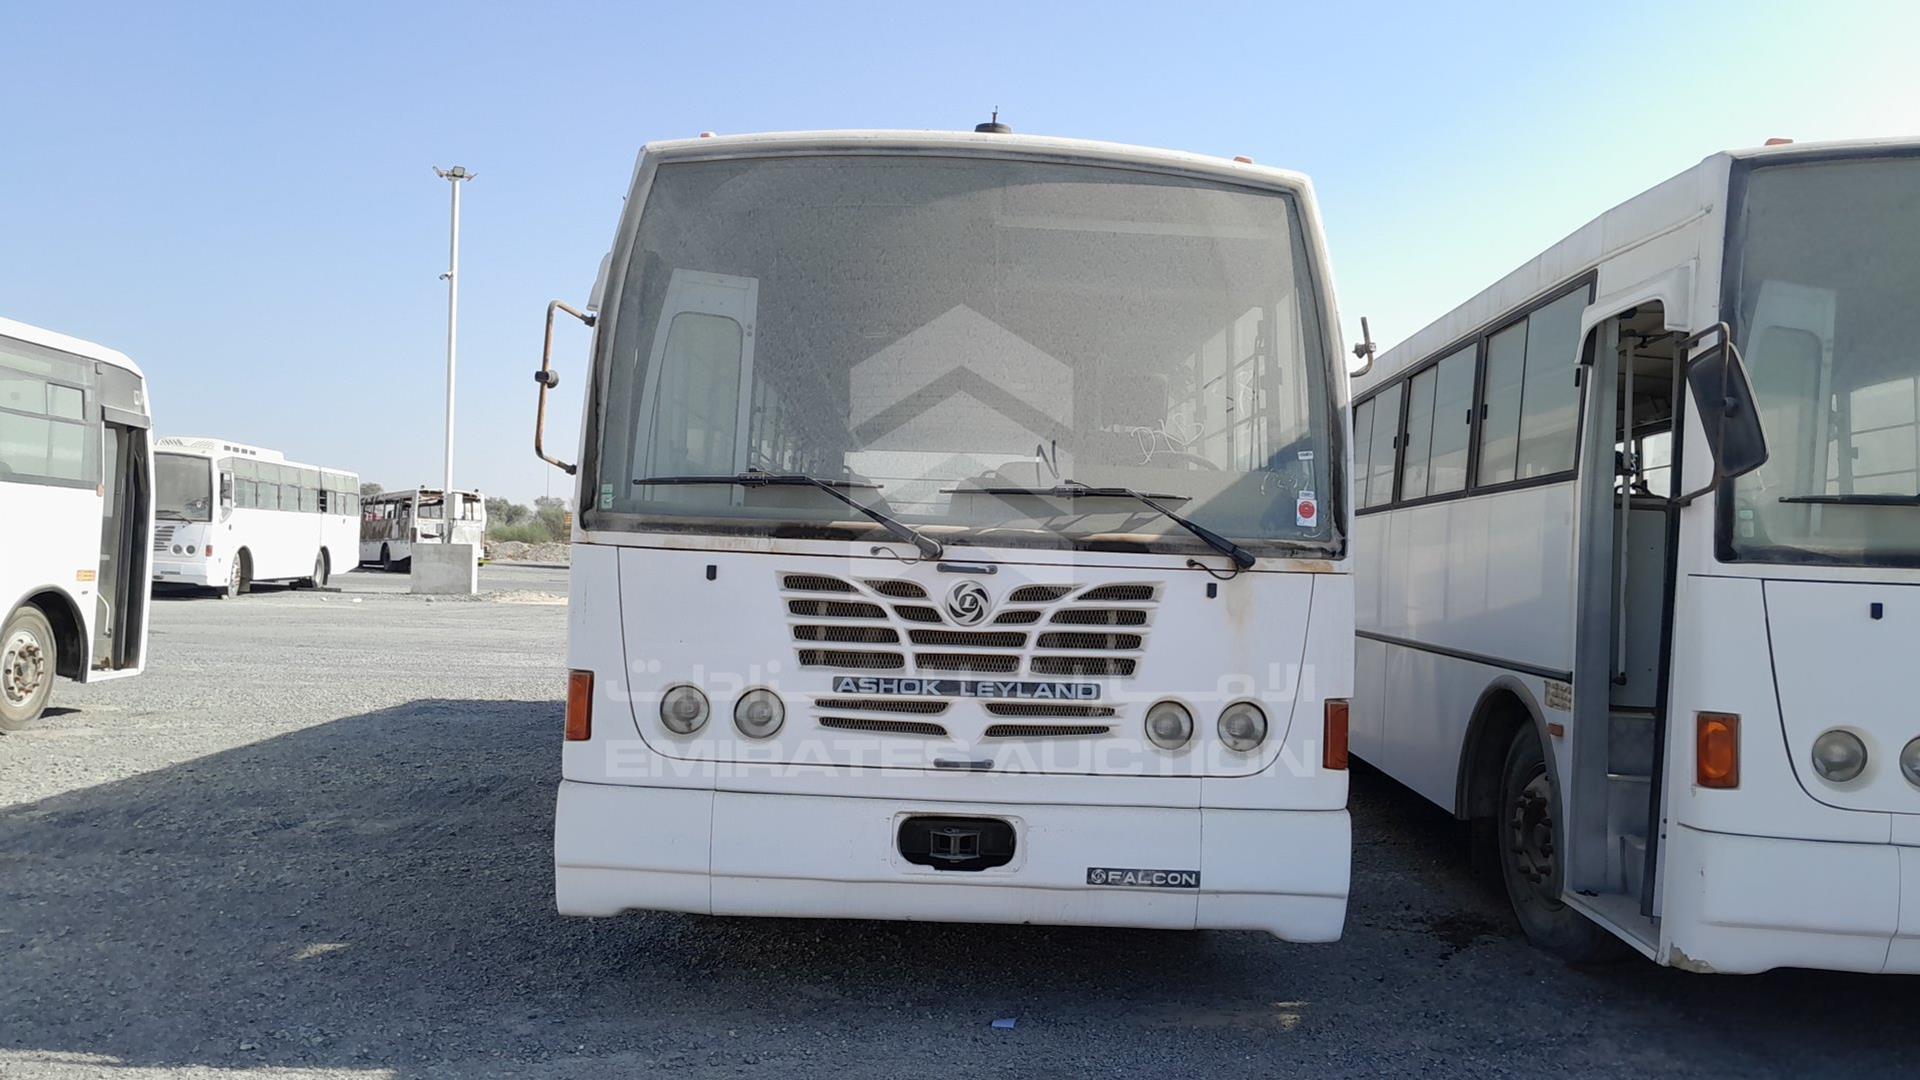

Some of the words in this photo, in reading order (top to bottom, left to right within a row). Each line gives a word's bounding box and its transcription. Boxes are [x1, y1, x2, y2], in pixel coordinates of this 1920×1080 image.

[836, 676, 942, 696] ASHOK
[960, 680, 1098, 700] LEYLAND
[1107, 871, 1196, 885] FALCON
